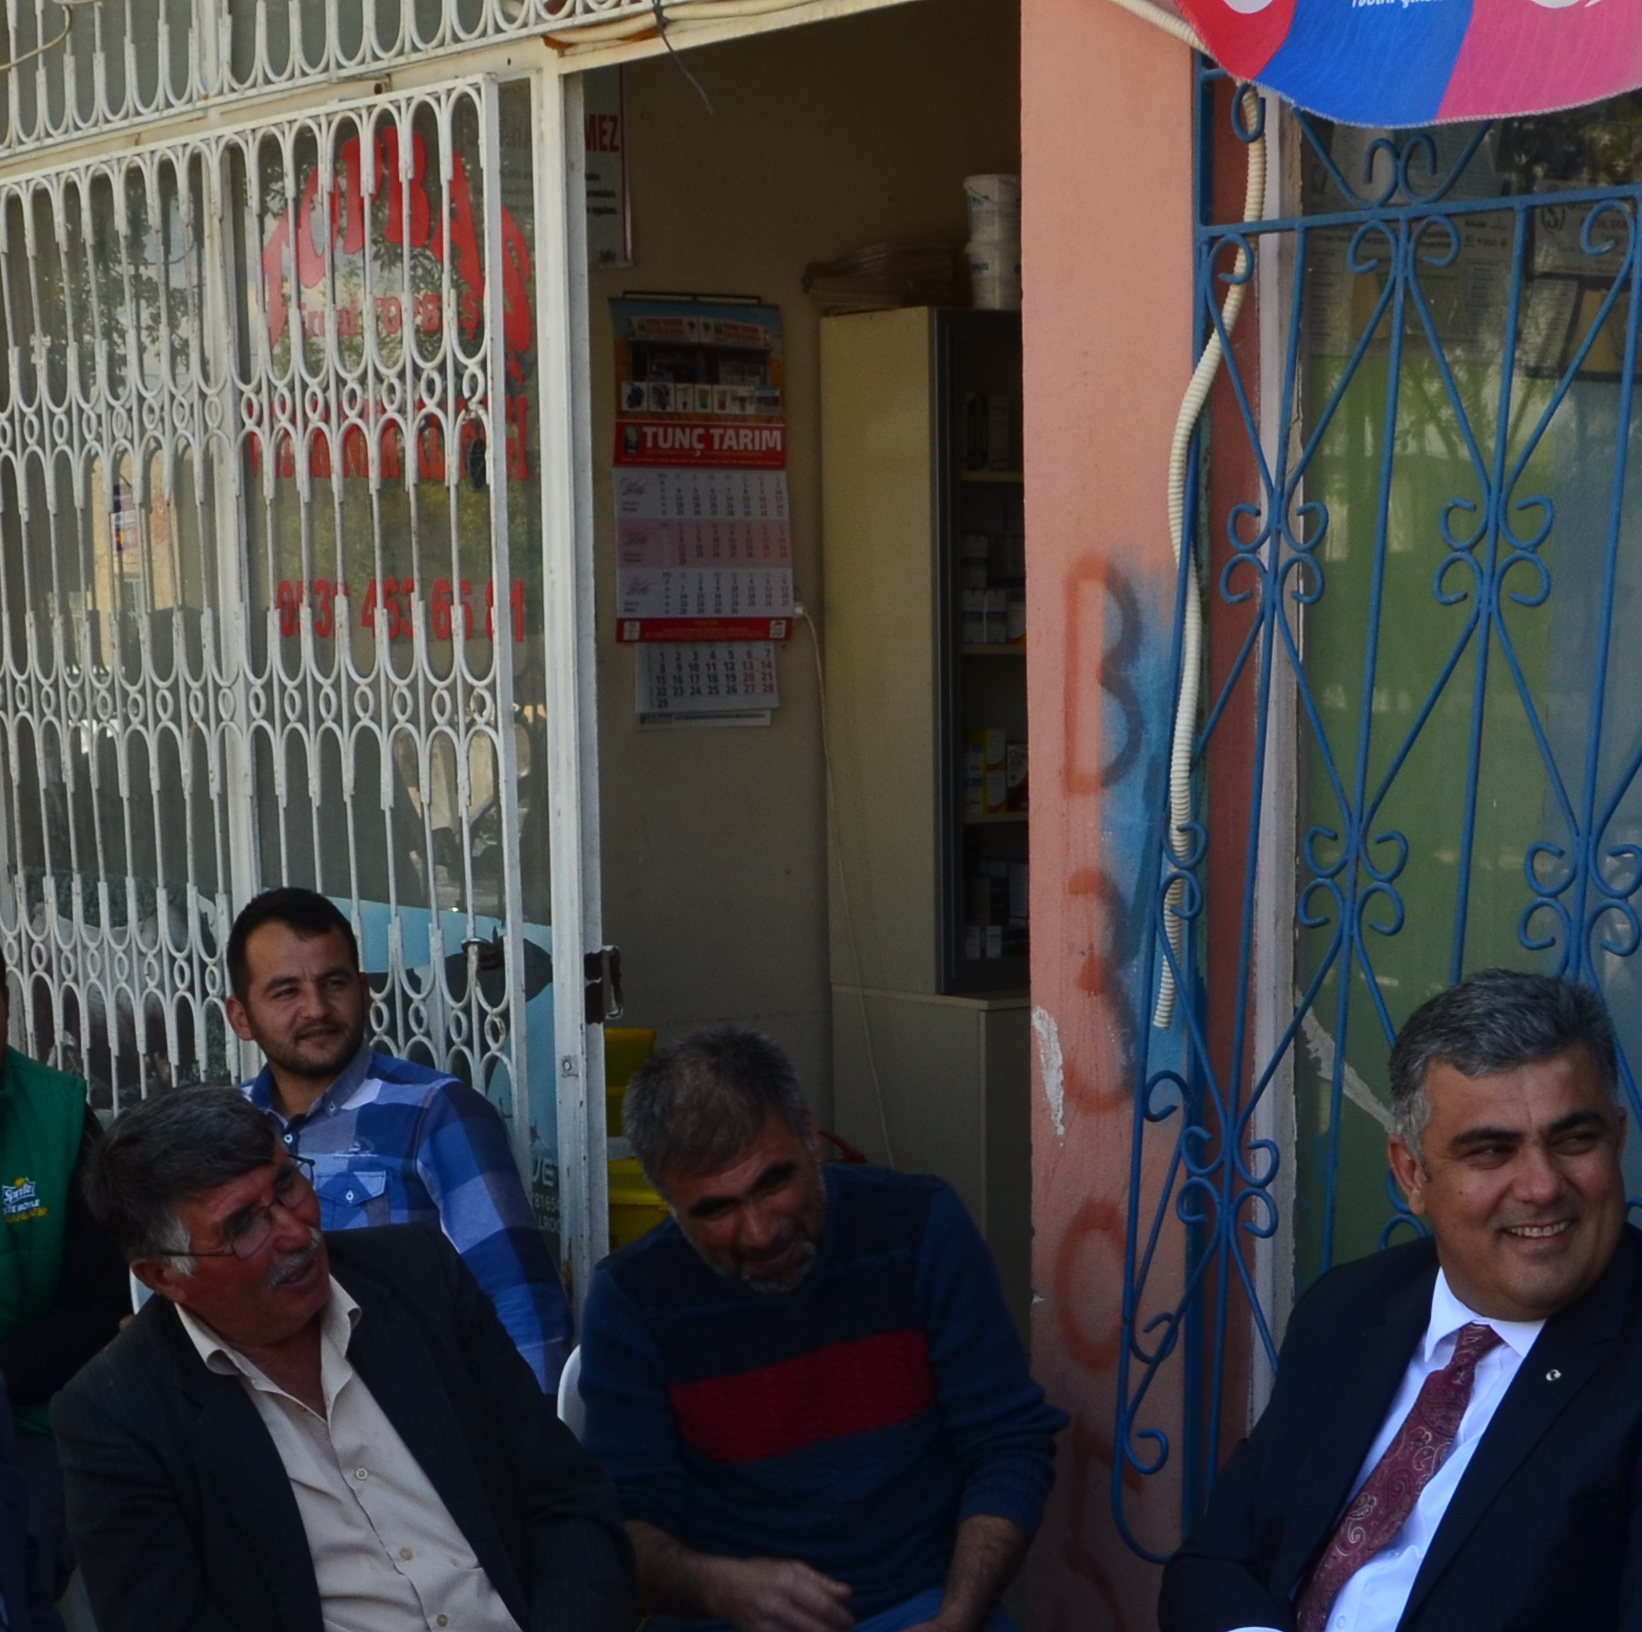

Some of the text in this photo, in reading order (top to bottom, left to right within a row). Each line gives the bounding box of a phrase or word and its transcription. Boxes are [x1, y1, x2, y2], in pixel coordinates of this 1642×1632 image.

[643, 426, 705, 458] TUNÇ
[710, 428, 783, 452] TARIM
[675, 652, 681, 661] 2
[693, 652, 698, 660] 3
[710, 651, 716, 660] 4
[728, 651, 734, 659] 5
[765, 649, 771, 658] 7
[660, 664, 665, 672] 8
[676, 663, 682, 672] 9
[689, 663, 699, 672] 10
[706, 663, 717, 671] 11
[724, 662, 735, 671] 12
[743, 661, 753, 670] 13
[657, 676, 666, 684] 15
[673, 675, 683, 683] 16
[690, 675, 700, 683] 17
[708, 675, 718, 683] 18
[725, 674, 736, 682] 19
[762, 673, 772, 681] 21
[657, 688, 667, 696] 22
[673, 687, 684, 696] 23
[690, 687, 701, 695] 24
[708, 686, 719, 694] 25
[726, 686, 737, 694] 26
[744, 685, 755, 693] 27
[657, 699, 668, 708] 29
[3, 1183, 33, 1203] Sprite
